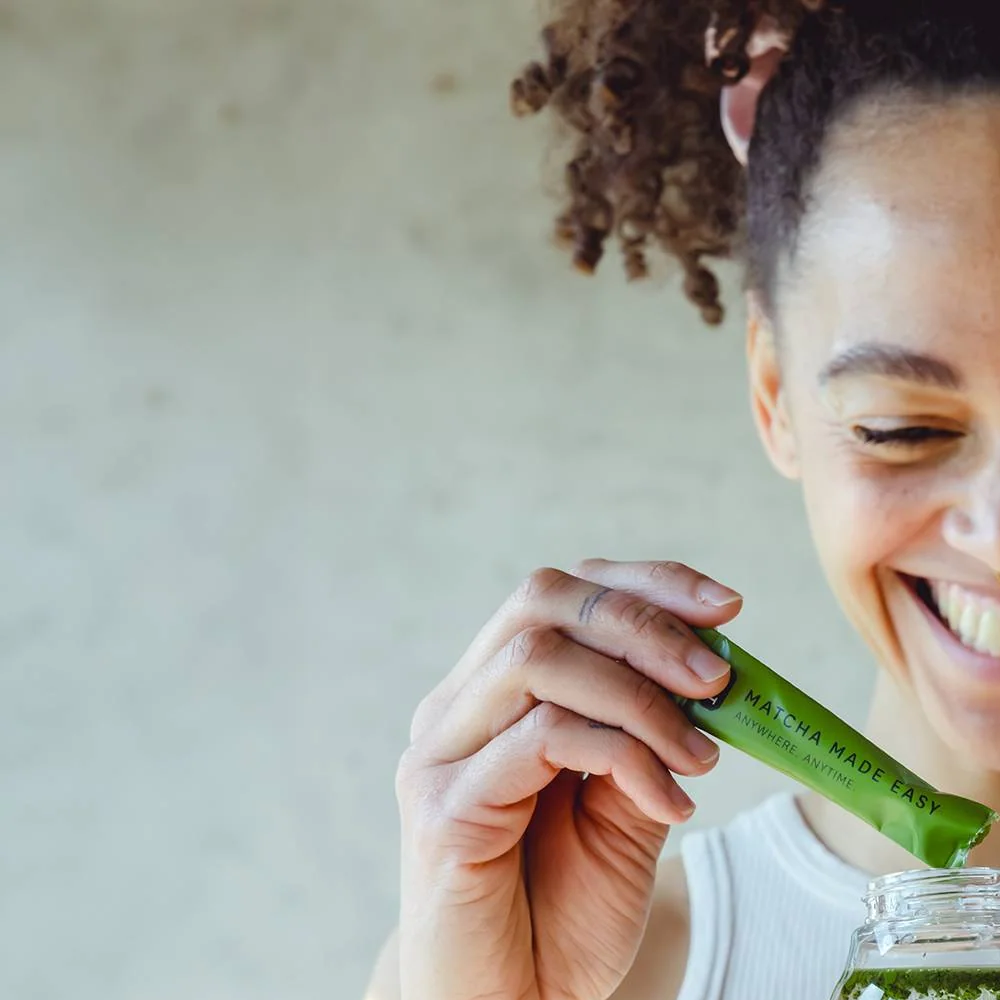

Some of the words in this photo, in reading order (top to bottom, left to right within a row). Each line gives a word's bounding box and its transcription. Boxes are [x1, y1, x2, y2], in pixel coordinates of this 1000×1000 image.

[744, 689, 821, 746] MATCHA
[829, 741, 885, 783] MADE
[890, 779, 941, 815] EASY
